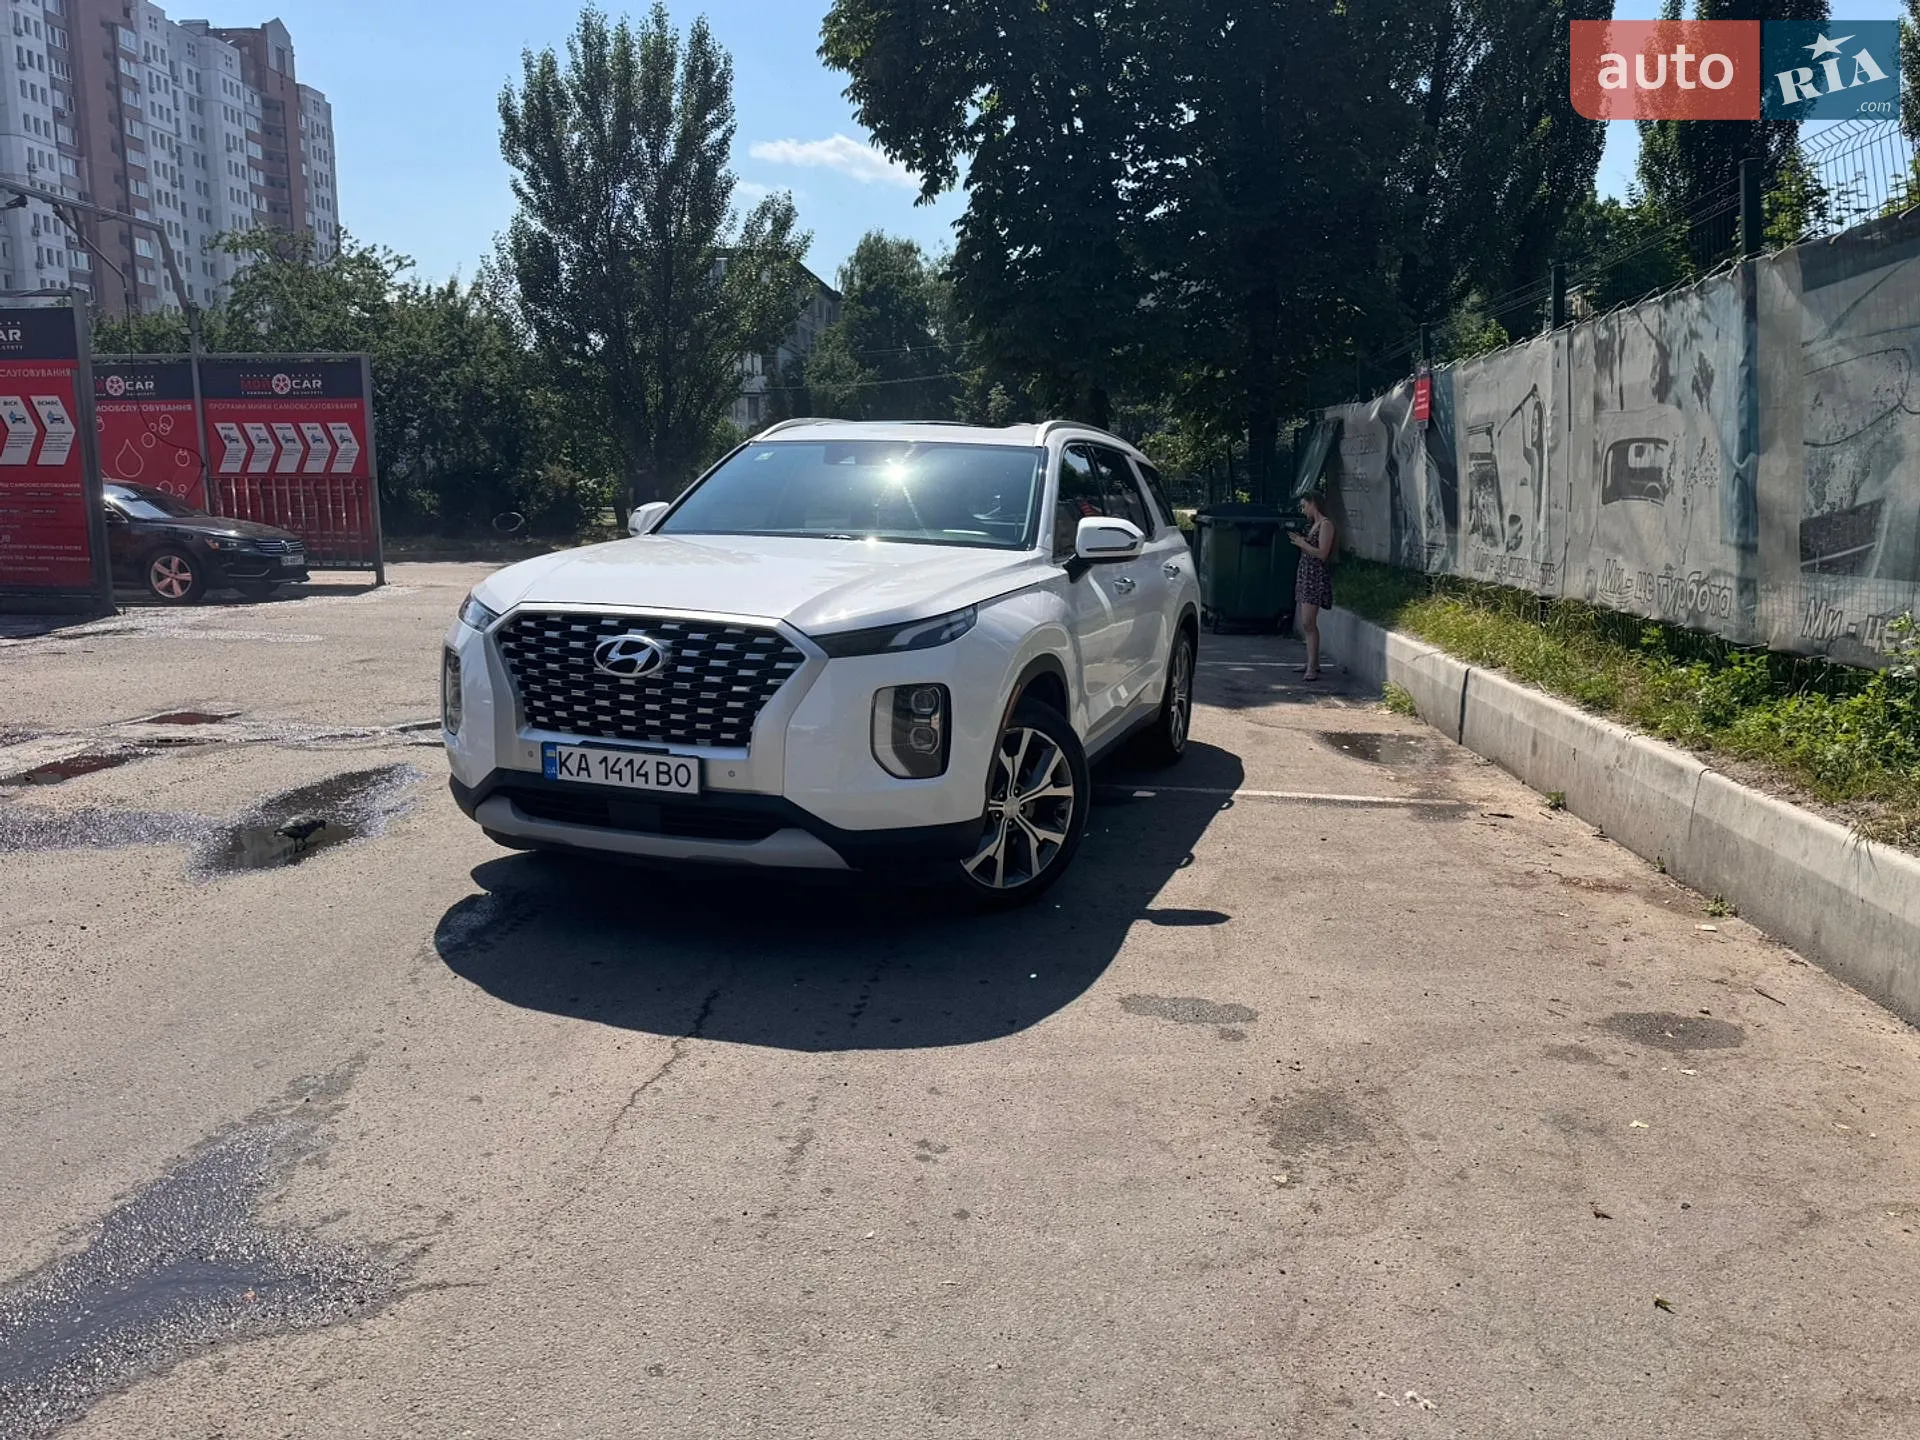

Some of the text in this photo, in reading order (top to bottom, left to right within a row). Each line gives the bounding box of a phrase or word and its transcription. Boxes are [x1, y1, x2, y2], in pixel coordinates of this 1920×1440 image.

[1599, 558, 1624, 595] Ми
[1634, 571, 1655, 604] це
[1656, 570, 1734, 620] турбота
[1801, 597, 1843, 641] Ми
[558, 750, 692, 788] KA 1414 BO
